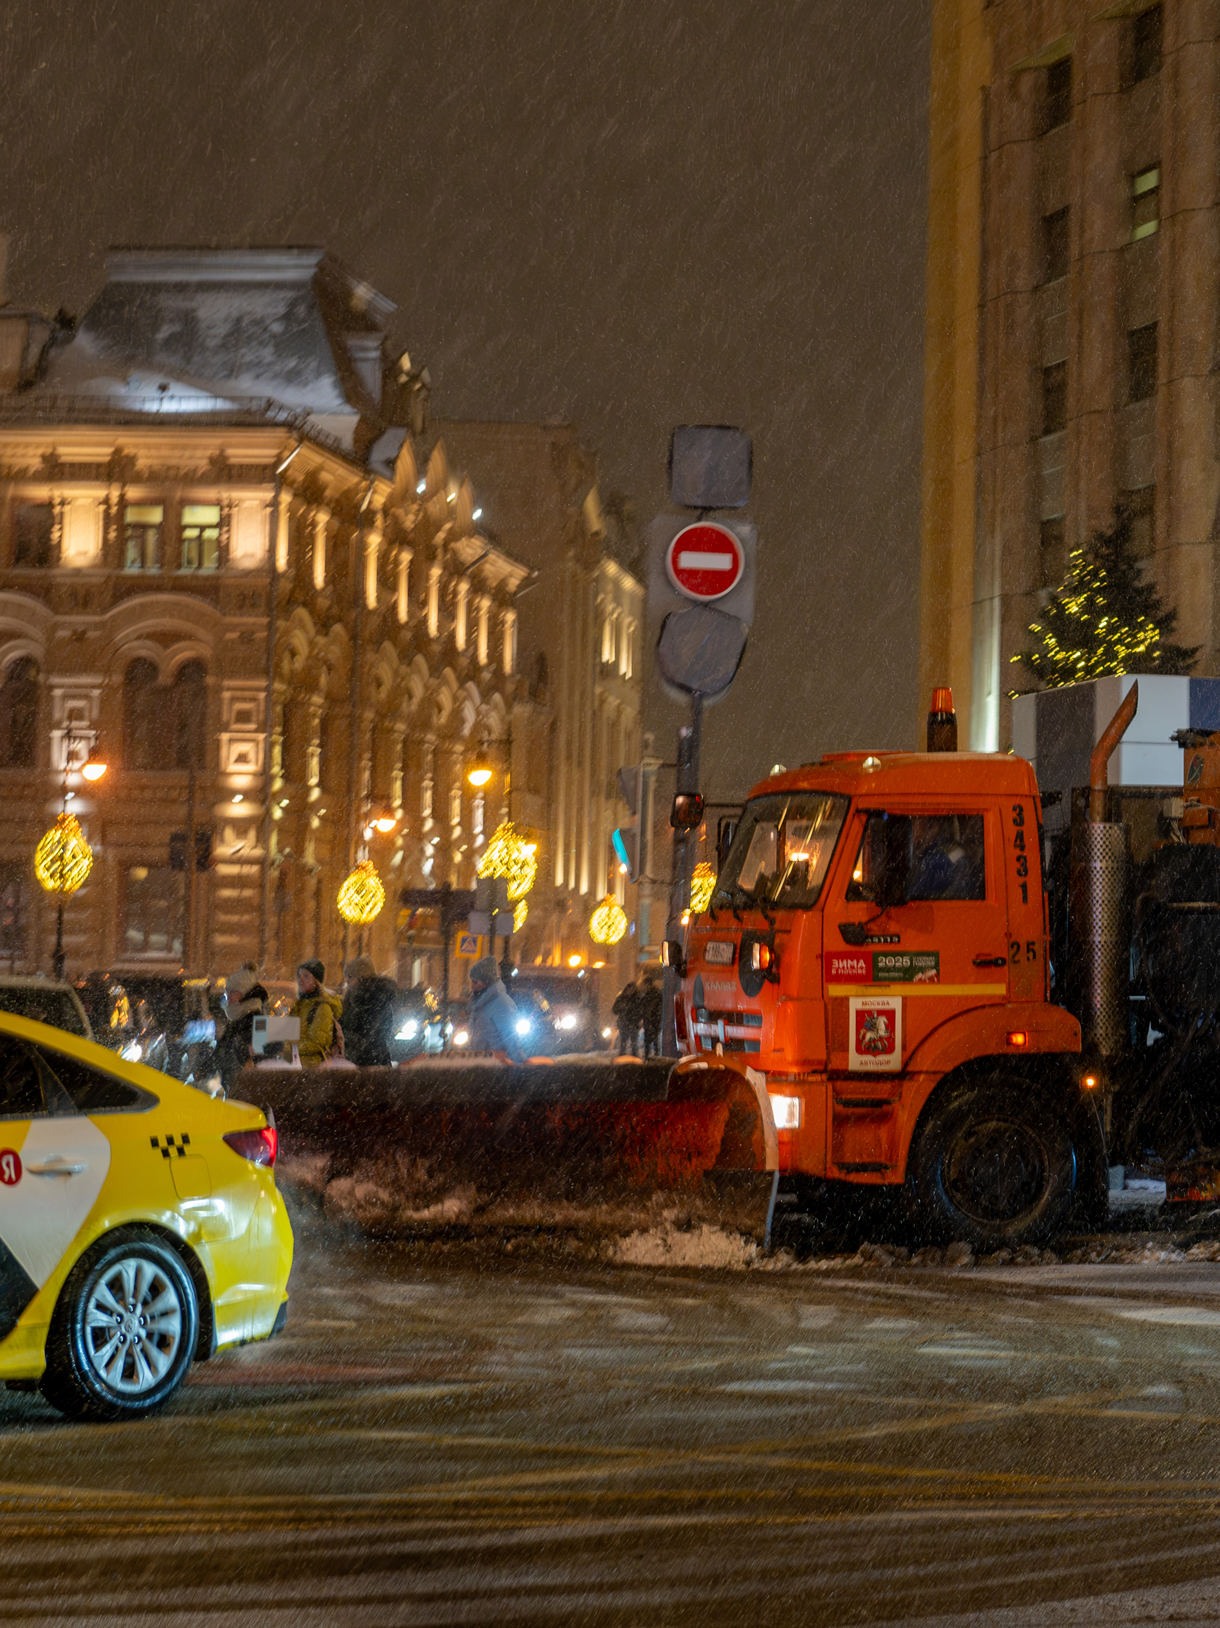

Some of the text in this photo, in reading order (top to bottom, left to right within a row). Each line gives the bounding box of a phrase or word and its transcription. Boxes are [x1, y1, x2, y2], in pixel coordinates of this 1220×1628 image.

[831, 959, 866, 969] ЗИМА
[877, 956, 910, 968] 2025
[2, 1153, 16, 1182] Я
